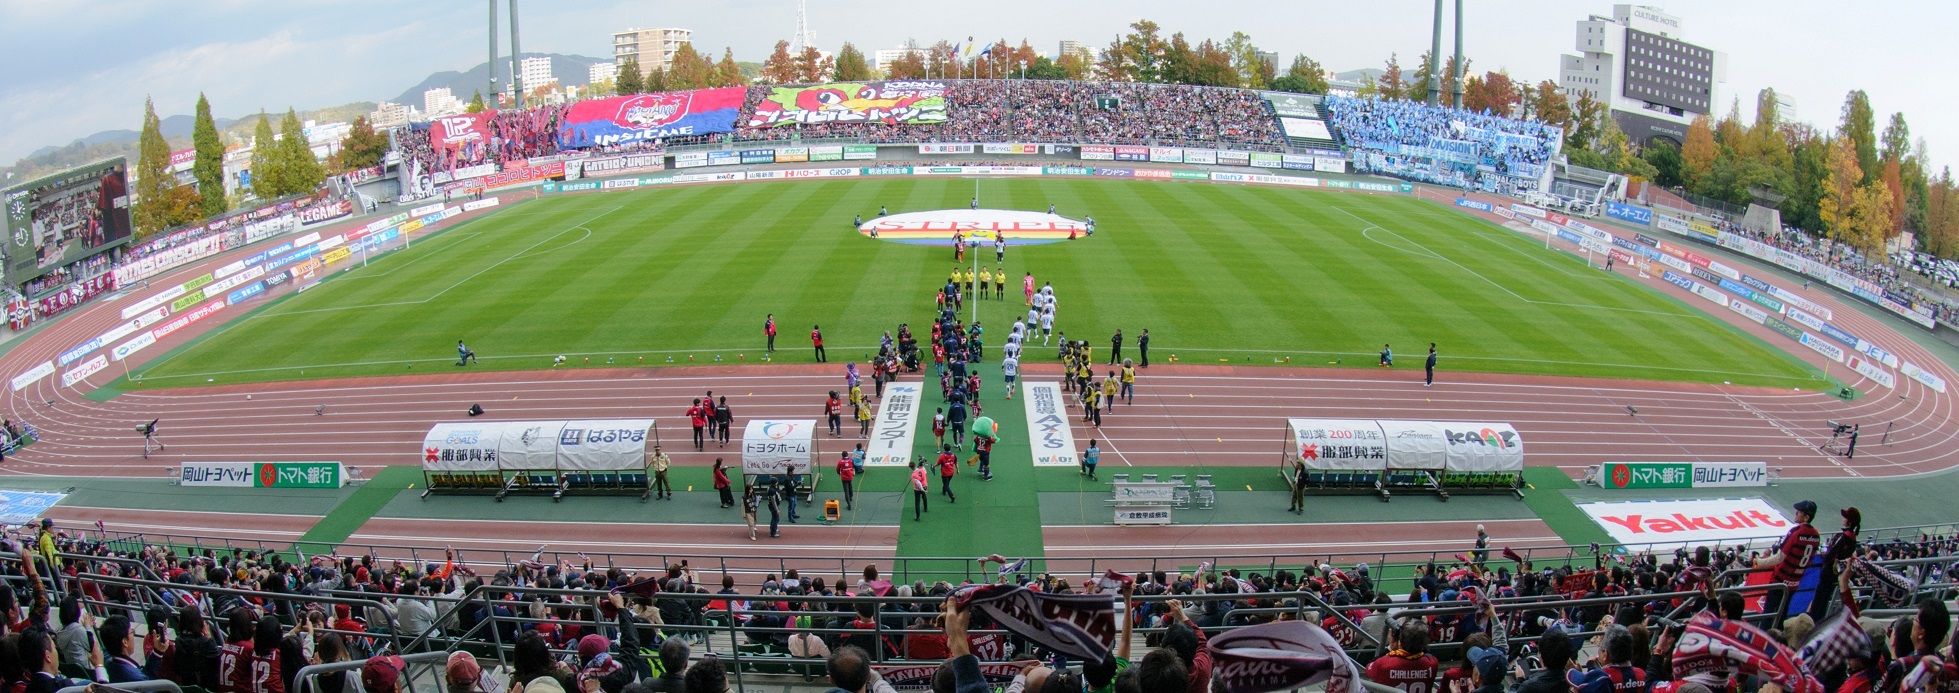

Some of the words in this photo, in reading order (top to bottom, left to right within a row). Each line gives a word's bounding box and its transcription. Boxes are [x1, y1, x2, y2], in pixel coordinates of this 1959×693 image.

[1634, 10, 1660, 22] CULTURE
[1660, 15, 1679, 28] HOTEL
[594, 126, 693, 145] INSIEME
[1430, 140, 1470, 153] DIVISION
[1470, 142, 1478, 155] 1
[488, 162, 563, 184] ココロヒトツニ
[562, 182, 597, 191] 明治安田生命
[300, 203, 343, 223] LEGAME
[1459, 200, 1488, 209] JR西日本
[1620, 207, 1650, 222] オーエム
[245, 213, 294, 238] INSIEME
[879, 221, 1079, 231] STRIPE
[116, 256, 155, 281] PATRES
[266, 272, 287, 286] TOMIYA
[1665, 271, 1691, 288] コアテック
[1808, 336, 1840, 355] HAGIHARA
[1863, 344, 1890, 362] JET
[1032, 386, 1057, 415] 個別指導
[880, 394, 914, 449] 能開センター
[446, 435, 478, 445] GOALS
[586, 429, 645, 443] はるやま
[441, 448, 497, 461] 服部興業
[747, 442, 806, 454] トヨタホーム
[1321, 444, 1385, 459] 服部興業
[746, 460, 760, 469] Let's
[762, 460, 770, 469] Go
[182, 466, 253, 482] 岡山トヨペット
[278, 467, 333, 484] トマト銀行
[1632, 467, 1686, 484] トマト銀行
[1693, 467, 1765, 483] 岡山トヨペット
[1600, 509, 1787, 535] Yakult
[1800, 545, 1813, 568] 8
[1438, 626, 1456, 643] 19
[220, 653, 236, 687] 12
[251, 661, 271, 693] 12
[1389, 668, 1428, 680] CHALLENGE
